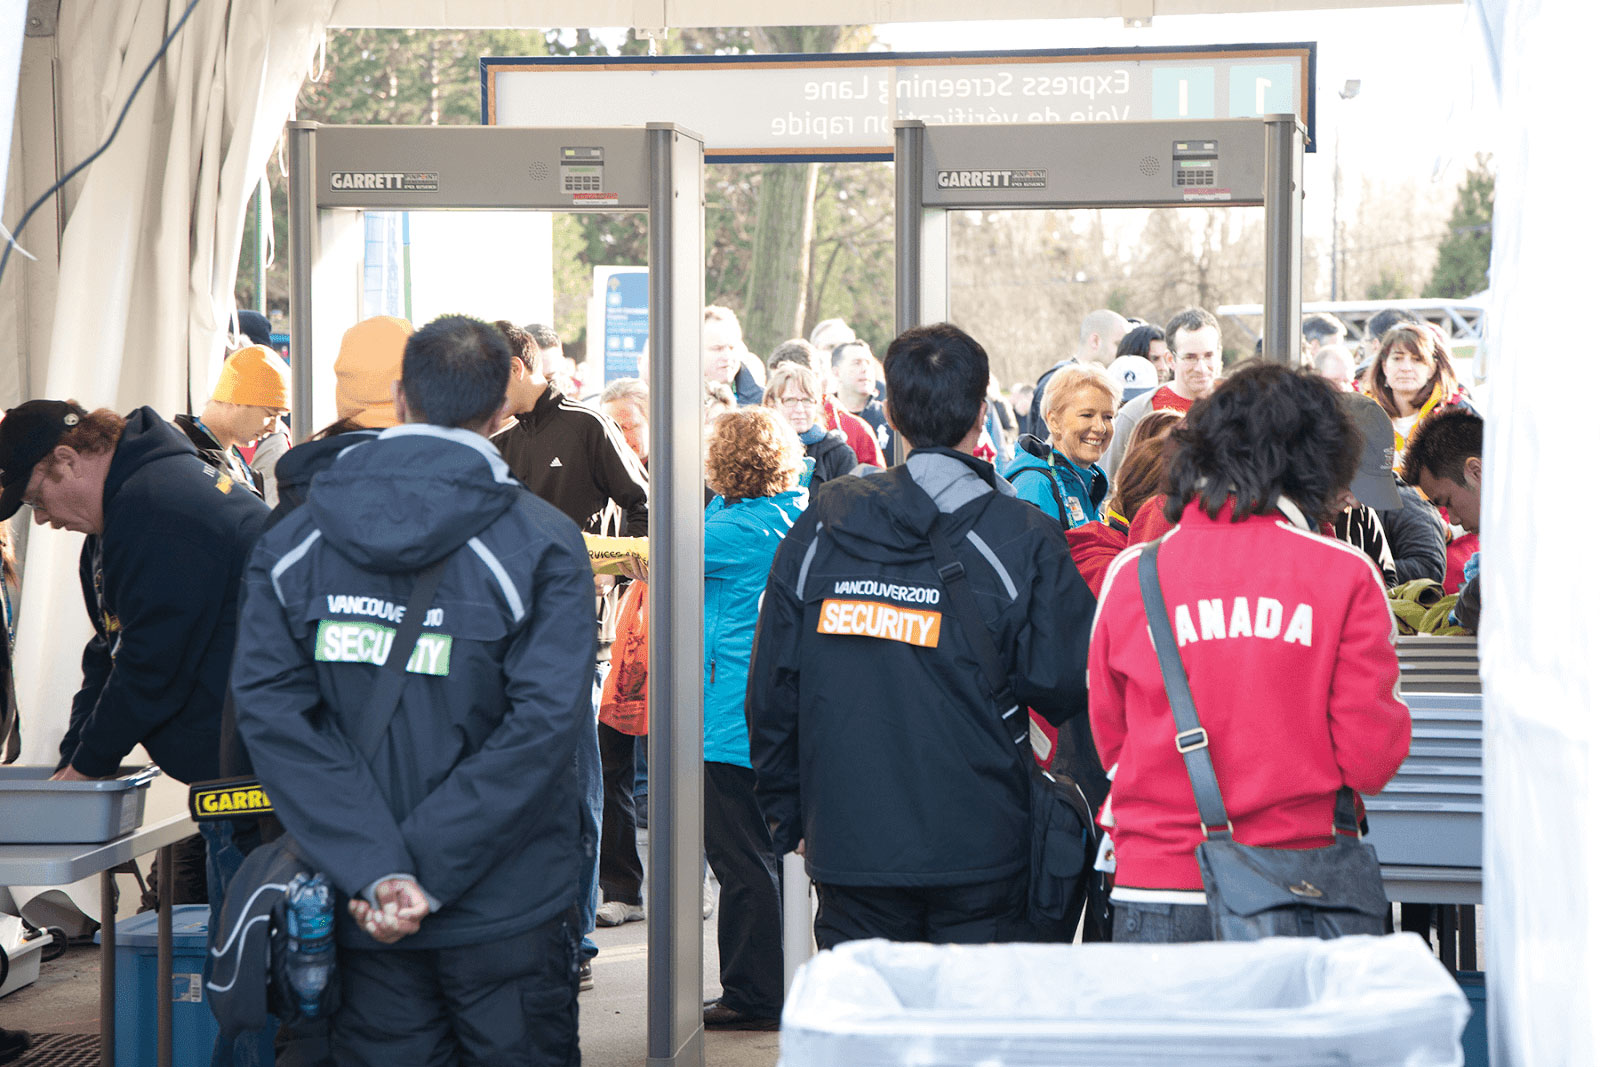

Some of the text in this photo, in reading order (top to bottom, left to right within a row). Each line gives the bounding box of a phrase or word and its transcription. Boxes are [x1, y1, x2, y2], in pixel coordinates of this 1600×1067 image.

[332, 173, 404, 189] GARRETT
[938, 171, 1012, 187] GARRETT
[835, 580, 940, 605] VANCOUVER2010
[327, 594, 445, 627] VANCOUVE10
[823, 602, 935, 646] SECURITY
[1146, 596, 1313, 648] ANADA
[323, 625, 445, 675] SECUTY
